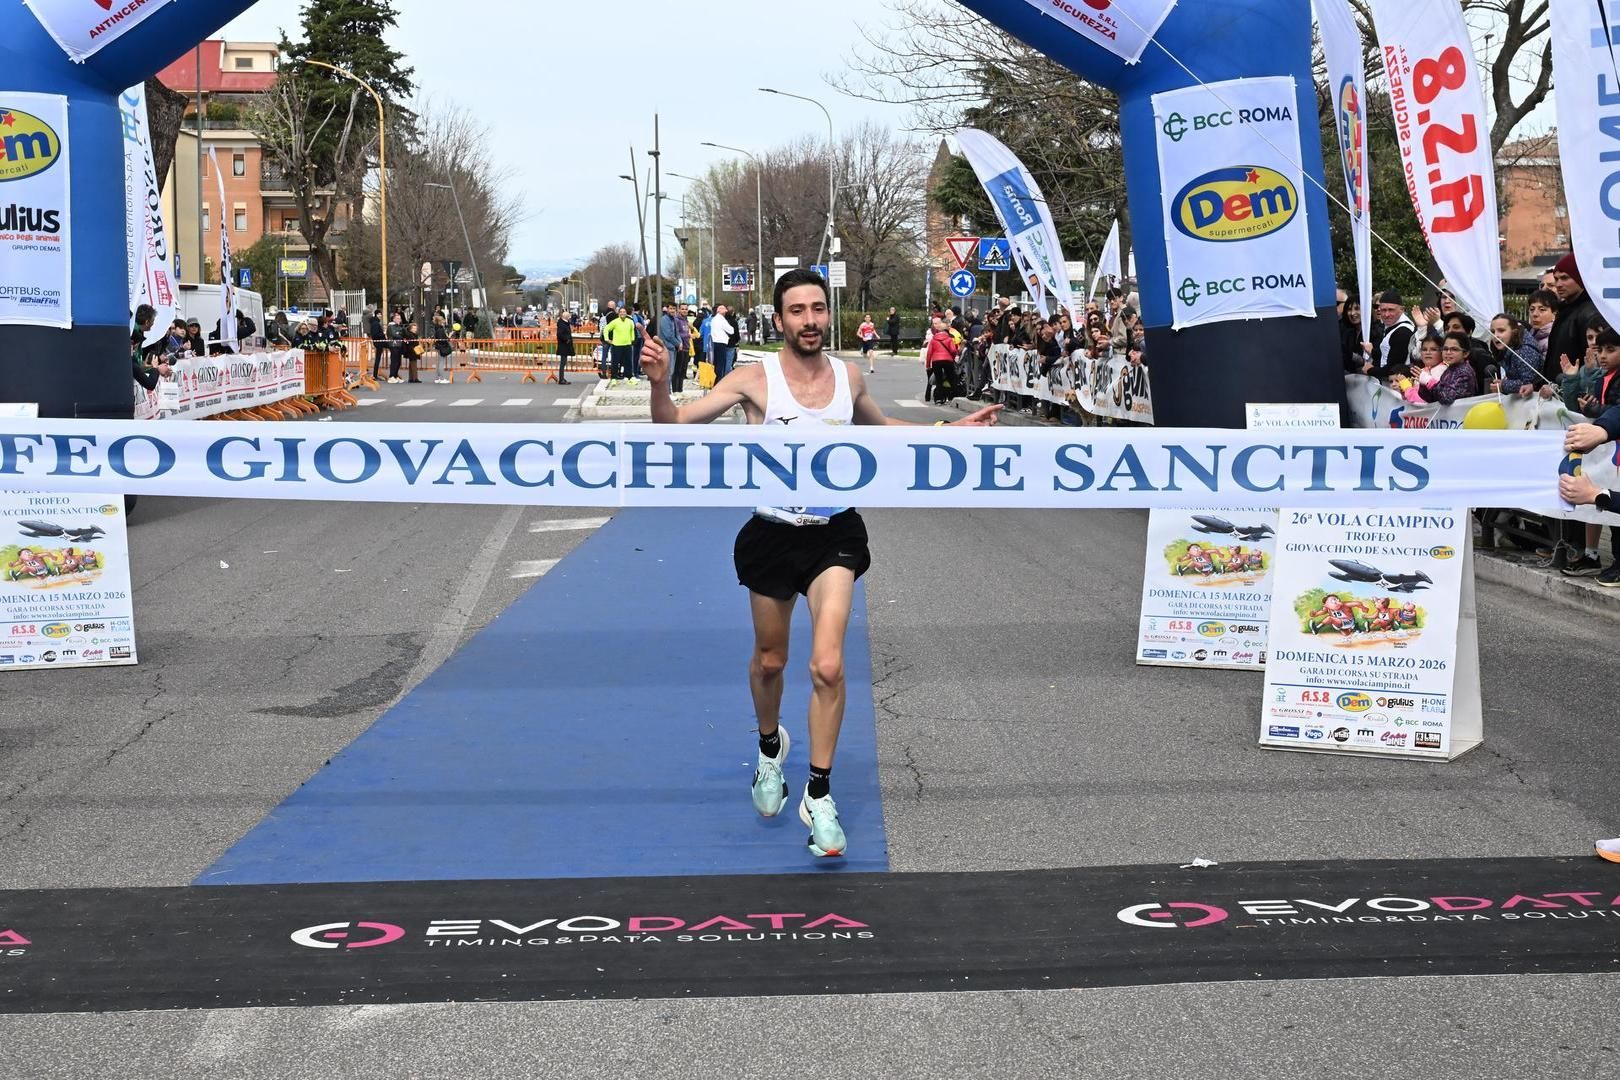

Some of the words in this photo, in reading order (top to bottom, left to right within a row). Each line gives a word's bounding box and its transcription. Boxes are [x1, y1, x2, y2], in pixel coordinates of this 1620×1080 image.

[1052, 0, 1116, 40] SICUREZZA
[1098, 13, 1118, 29] S.R.L.
[1193, 111, 1233, 130] BCC
[1238, 106, 1292, 124] ROMA
[1188, 185, 1292, 229] Dem
[1208, 220, 1274, 237] supermercati
[1206, 278, 1246, 296] BCC
[1251, 274, 1306, 290] ROMA
[0, 434, 177, 479] FEO
[205, 435, 878, 492] GIOVACCHINO
[906, 443, 1025, 492] DE
[1053, 443, 1431, 493] SANCTIS
[27, 497, 70, 506] TROFEO
[46, 508, 57, 516] DE
[59, 507, 100, 516] SANCTIS
[1316, 513, 1362, 527] VOLA
[1365, 514, 1455, 530] CIAMPINO
[1345, 532, 1396, 543] TROFEO
[1285, 543, 1363, 555] GIOVACCHINO
[1365, 545, 1379, 555] DE
[1382, 546, 1428, 557] SANCTIS
[48, 593, 60, 602] 15
[62, 592, 101, 601] MARZO
[104, 591, 126, 600] 2026
[1149, 588, 1207, 600] DOMENICA
[1209, 592, 1220, 600] 15
[1222, 592, 1261, 601] MARZO
[1276, 650, 1348, 665] DOMENICA
[1351, 655, 1364, 665] 15
[1367, 656, 1416, 669] MARZO
[1418, 659, 1446, 670] 2026
[1300, 667, 1324, 675] GARA
[1326, 668, 1336, 676] DI
[1338, 669, 1368, 678] CORSA
[1369, 671, 1381, 679] SU
[1382, 672, 1419, 681] STRADA
[1306, 676, 1325, 684] info:
[1327, 678, 1411, 690] www.volaciampino.it
[1301, 691, 1330, 703] A.S.8
[1342, 696, 1370, 708] Dem
[1237, 891, 1620, 916] EVODAT
[425, 912, 870, 937] EVODATA
[1256, 914, 1491, 928] TIMING&DATA
[424, 935, 662, 948] TIMING&DATA
[677, 931, 875, 943] SOLUTIONS
